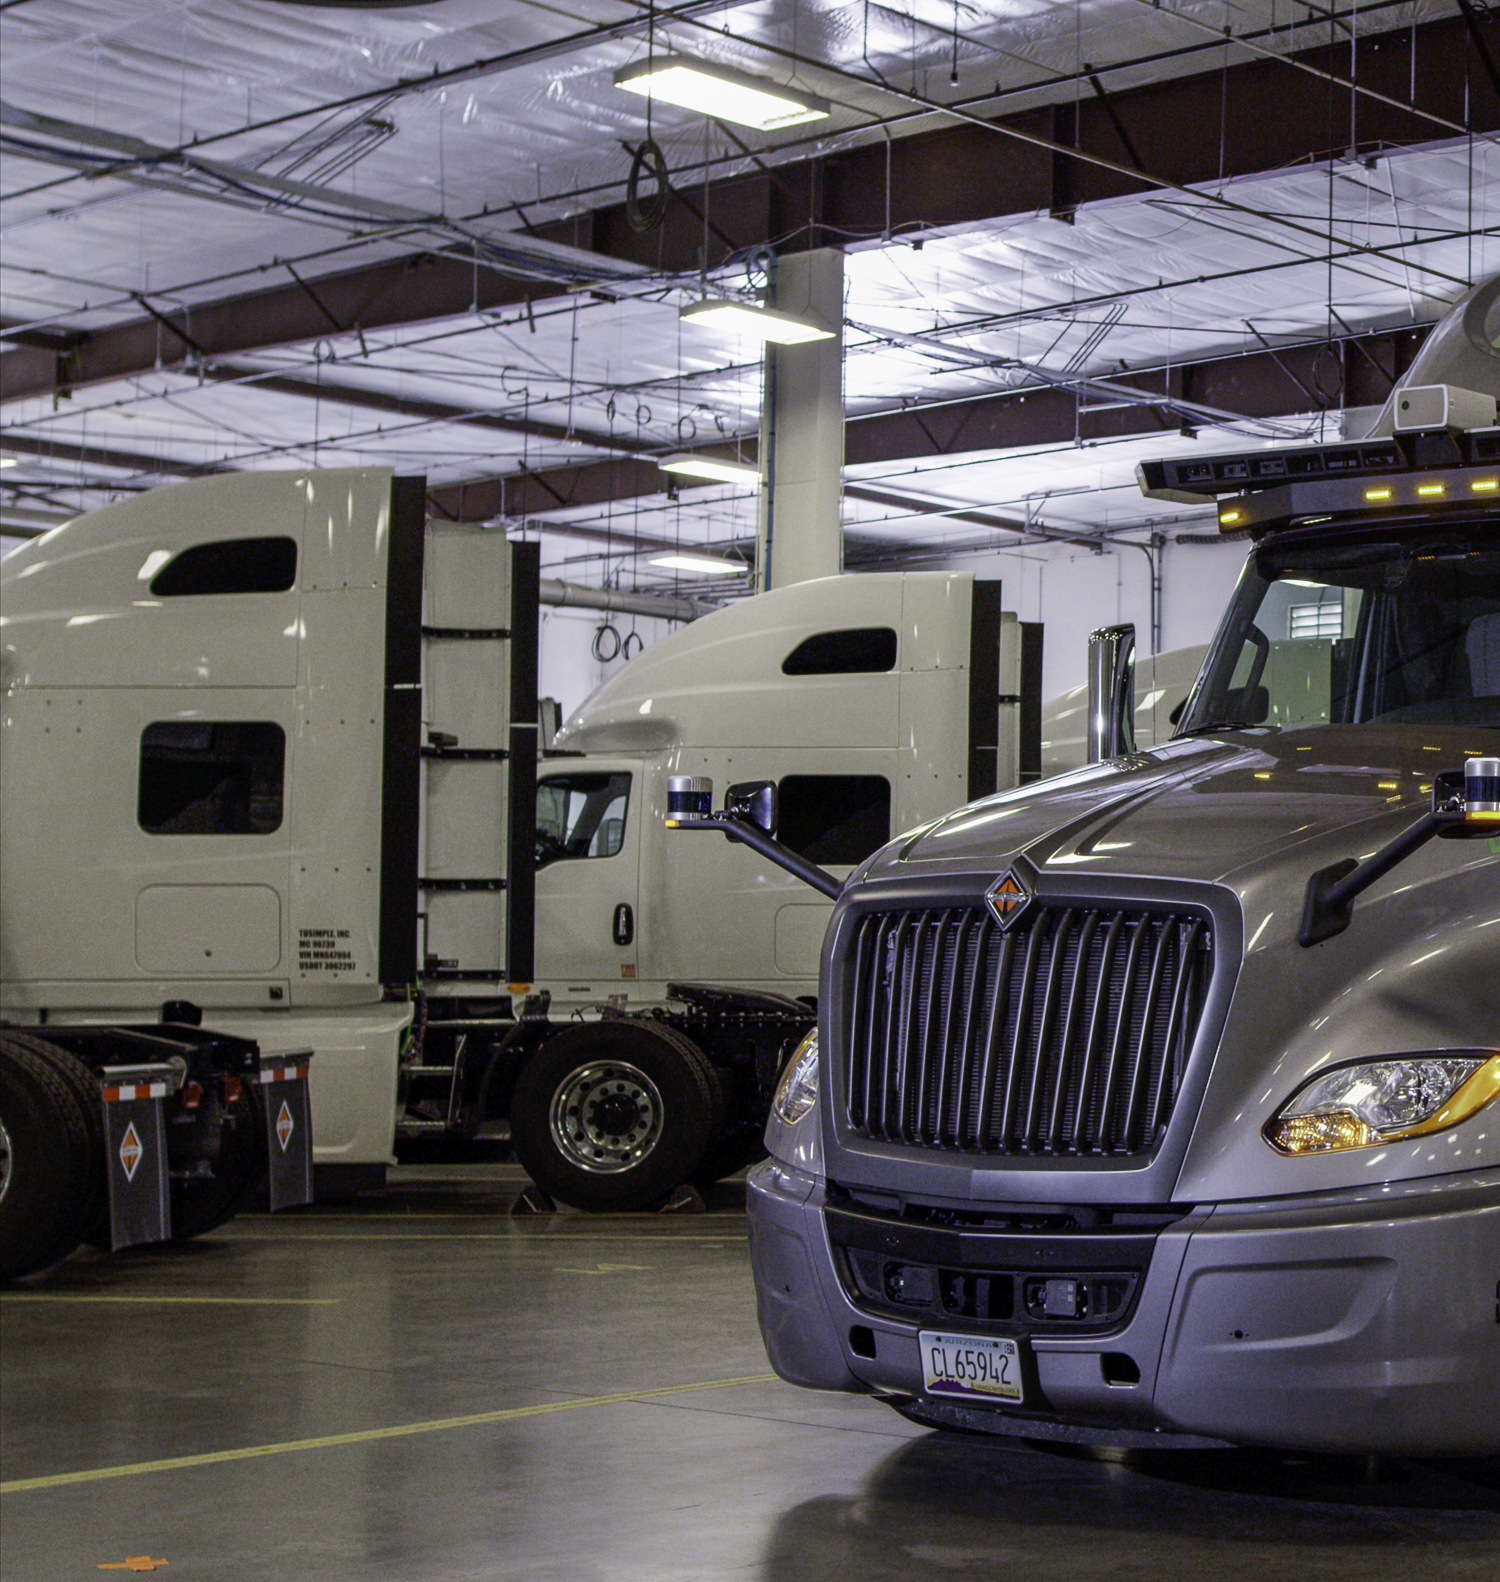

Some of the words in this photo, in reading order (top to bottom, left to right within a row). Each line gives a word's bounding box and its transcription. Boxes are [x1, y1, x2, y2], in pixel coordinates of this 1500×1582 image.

[299, 940, 311, 949] MC
[299, 951, 312, 960] VIN
[299, 962, 322, 970] USDOT
[945, 1338, 993, 1348] ARIZONA
[931, 1347, 1012, 1385] CL65942
